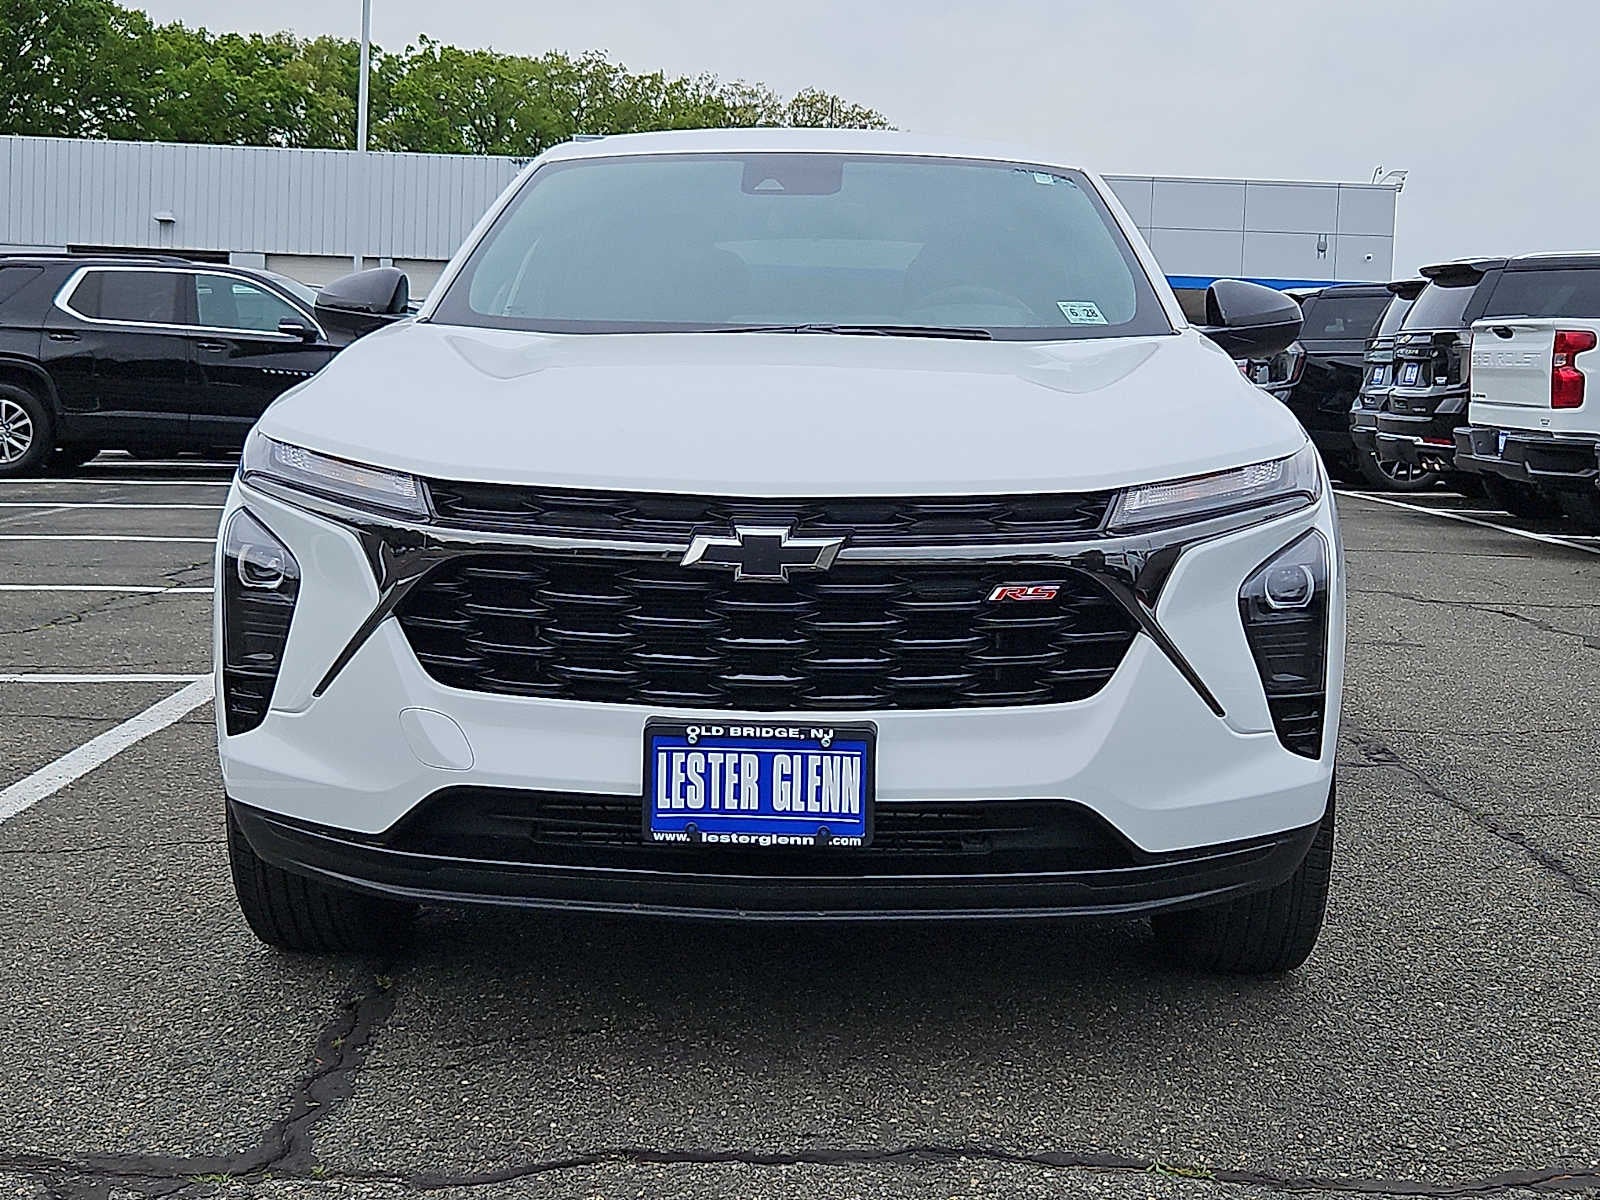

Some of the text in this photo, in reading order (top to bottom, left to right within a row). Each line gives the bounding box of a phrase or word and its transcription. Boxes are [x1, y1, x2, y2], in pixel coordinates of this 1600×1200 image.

[988, 585, 1060, 601] RS
[686, 726, 834, 739] OLD BRIDGE, NJ
[657, 752, 861, 814] LESTER GLENN
[701, 832, 815, 846] lesterglenn
